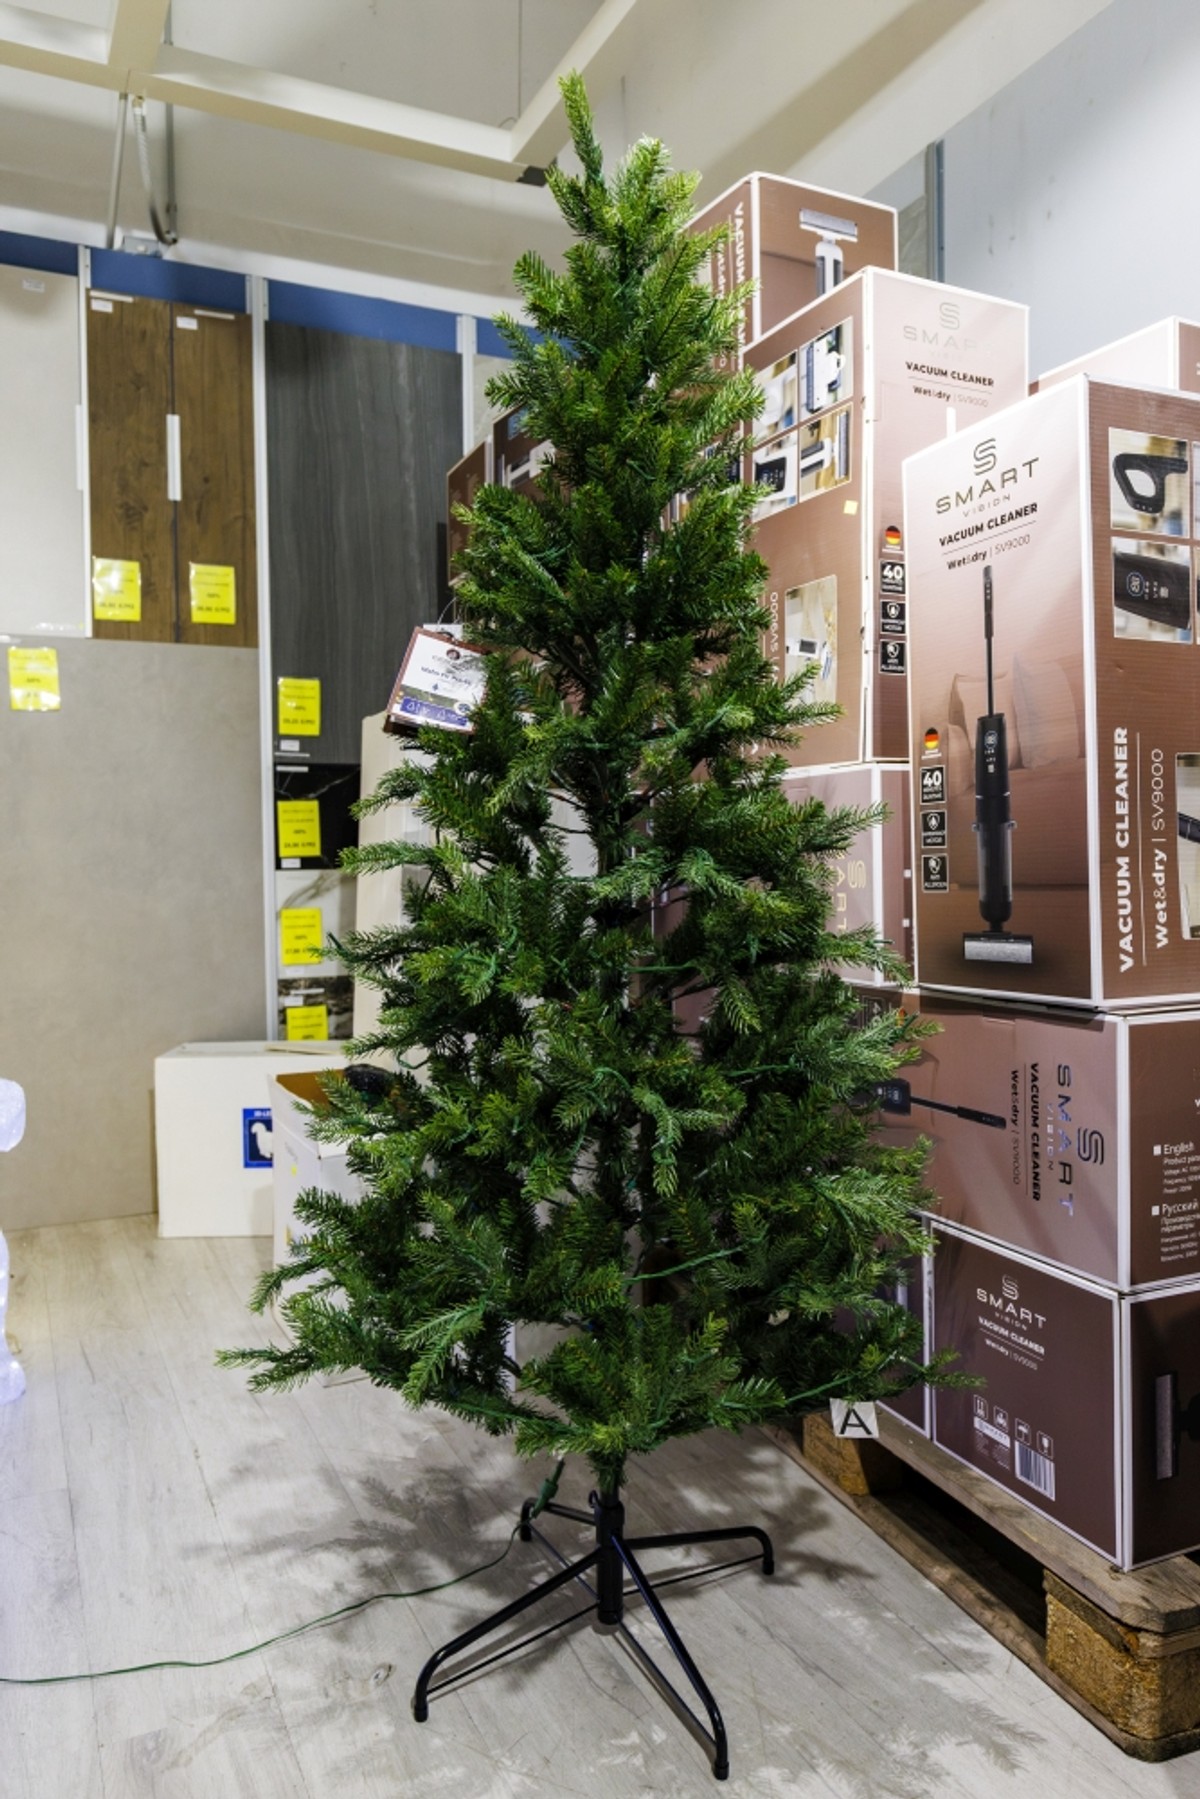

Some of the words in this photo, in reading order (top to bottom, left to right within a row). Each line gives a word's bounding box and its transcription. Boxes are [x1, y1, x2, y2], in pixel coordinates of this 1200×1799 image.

[905, 361, 948, 377] VACUUM
[950, 370, 995, 387] CLEANER
[935, 457, 1039, 514] SMART
[939, 522, 984, 547] VACUUM
[987, 502, 1038, 530] CLEANER
[884, 564, 904, 580] 40
[946, 550, 987, 570] Wet&dry
[994, 533, 1031, 555] SV9000
[923, 770, 942, 787] 40
[1114, 726, 1130, 849] CLEANER
[1151, 748, 1166, 832] SV9000
[1116, 856, 1135, 973] VACUUM
[1151, 848, 1169, 949] Wet&dry
[1011, 1069, 1020, 1127] Wet&dry
[1030, 1062, 1040, 1129] VACUUM
[1047, 1103, 1055, 1171] VISION
[1057, 1063, 1074, 1218] SMART
[1163, 1142, 1195, 1156] English
[1031, 1132, 1041, 1202] CLEANER
[1162, 1198, 1198, 1217] Русский
[976, 1287, 1047, 1330] SMART
[978, 1315, 1009, 1338] VACUUM
[1009, 1331, 1045, 1356] CLEANER
[839, 1407, 873, 1436] A
